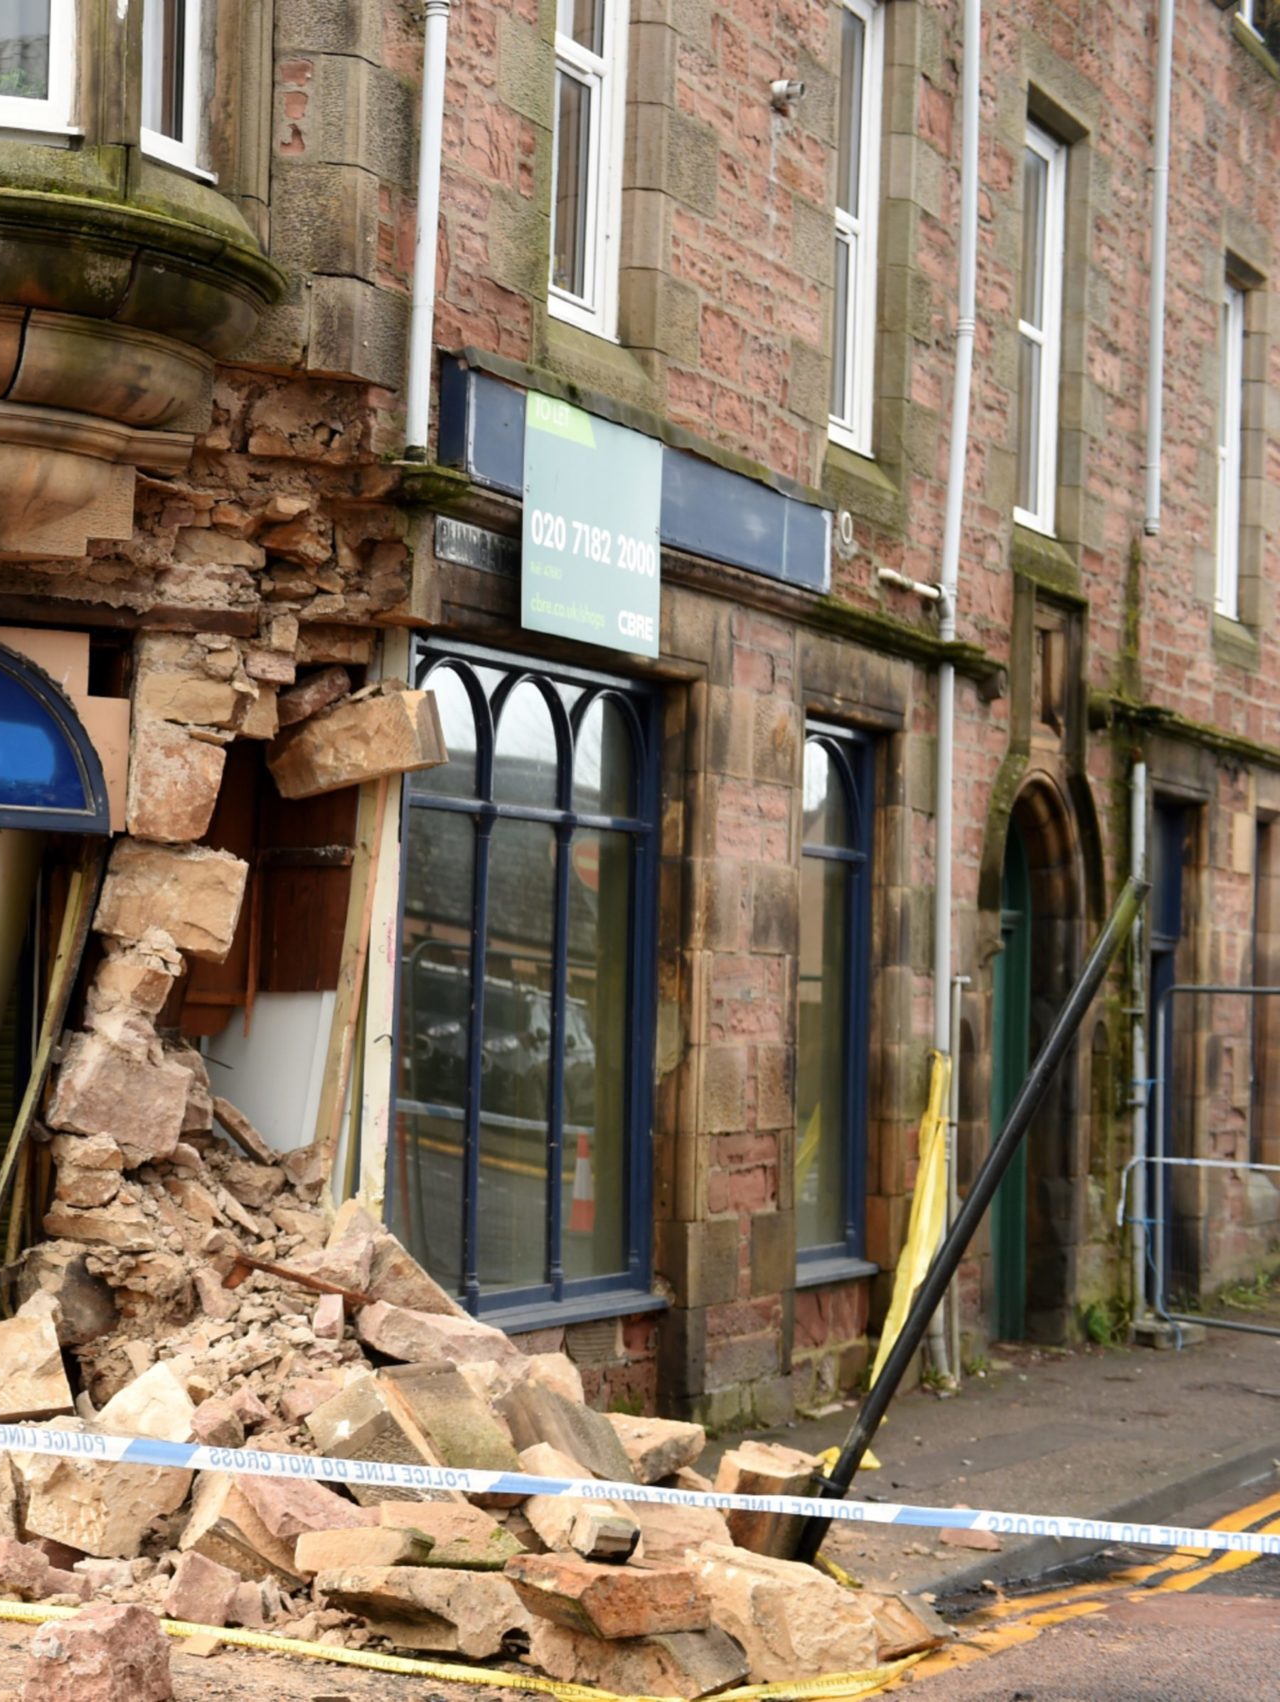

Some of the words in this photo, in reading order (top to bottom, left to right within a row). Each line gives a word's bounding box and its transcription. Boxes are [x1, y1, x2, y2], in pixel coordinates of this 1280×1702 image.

[531, 509, 566, 551] 020
[572, 520, 611, 565] 7182
[617, 534, 656, 578] 2000
[617, 609, 654, 642] CBRE
